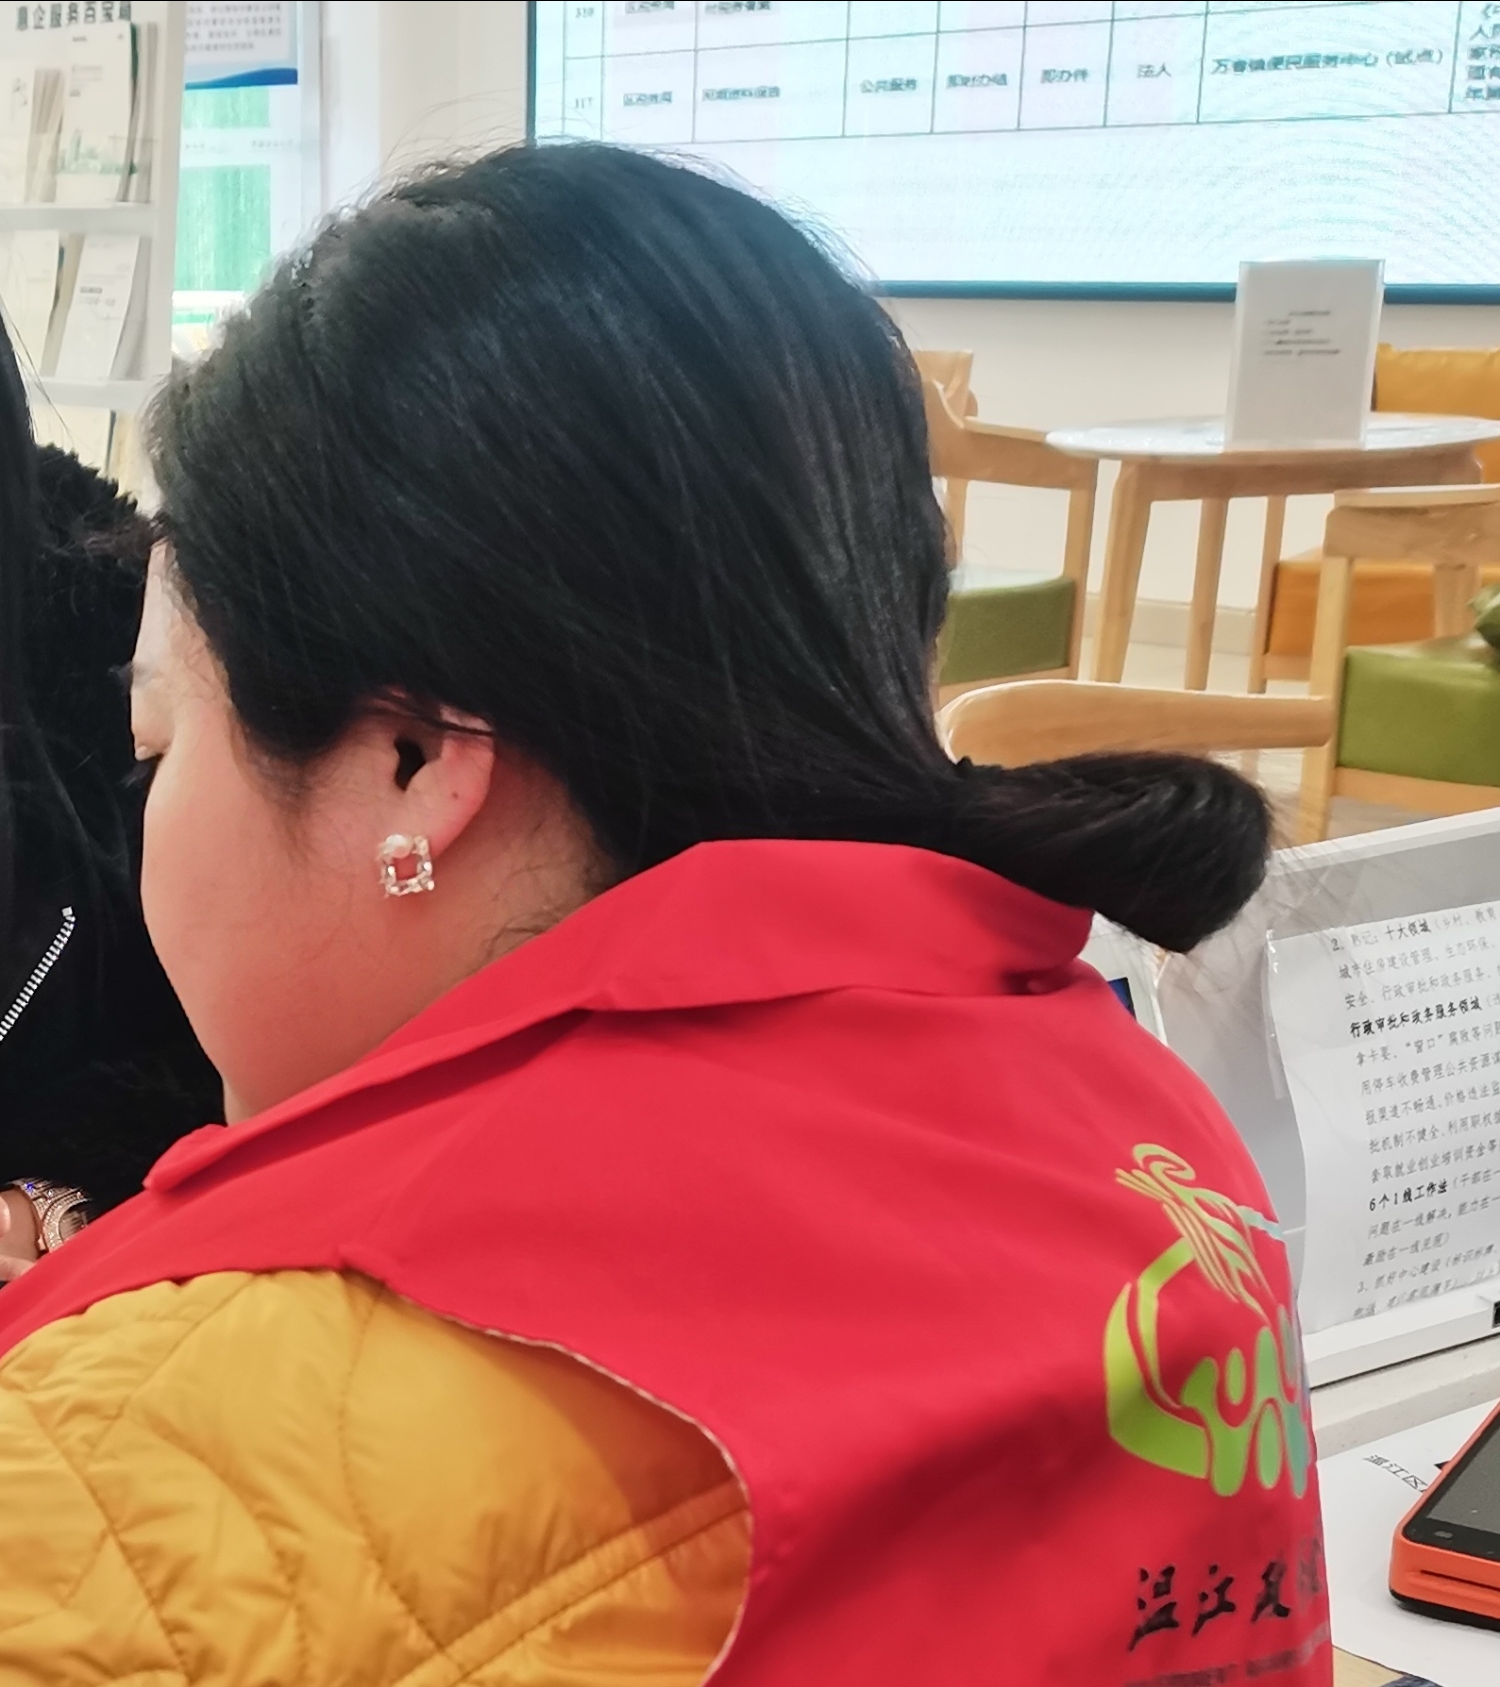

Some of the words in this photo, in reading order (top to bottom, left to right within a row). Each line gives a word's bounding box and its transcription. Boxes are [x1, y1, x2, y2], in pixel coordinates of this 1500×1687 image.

[1137, 61, 1172, 79] 法人
[1345, 965, 1500, 1010] 安全、行政审批和政务服务、
[1362, 1453, 1429, 1494] 温江区
